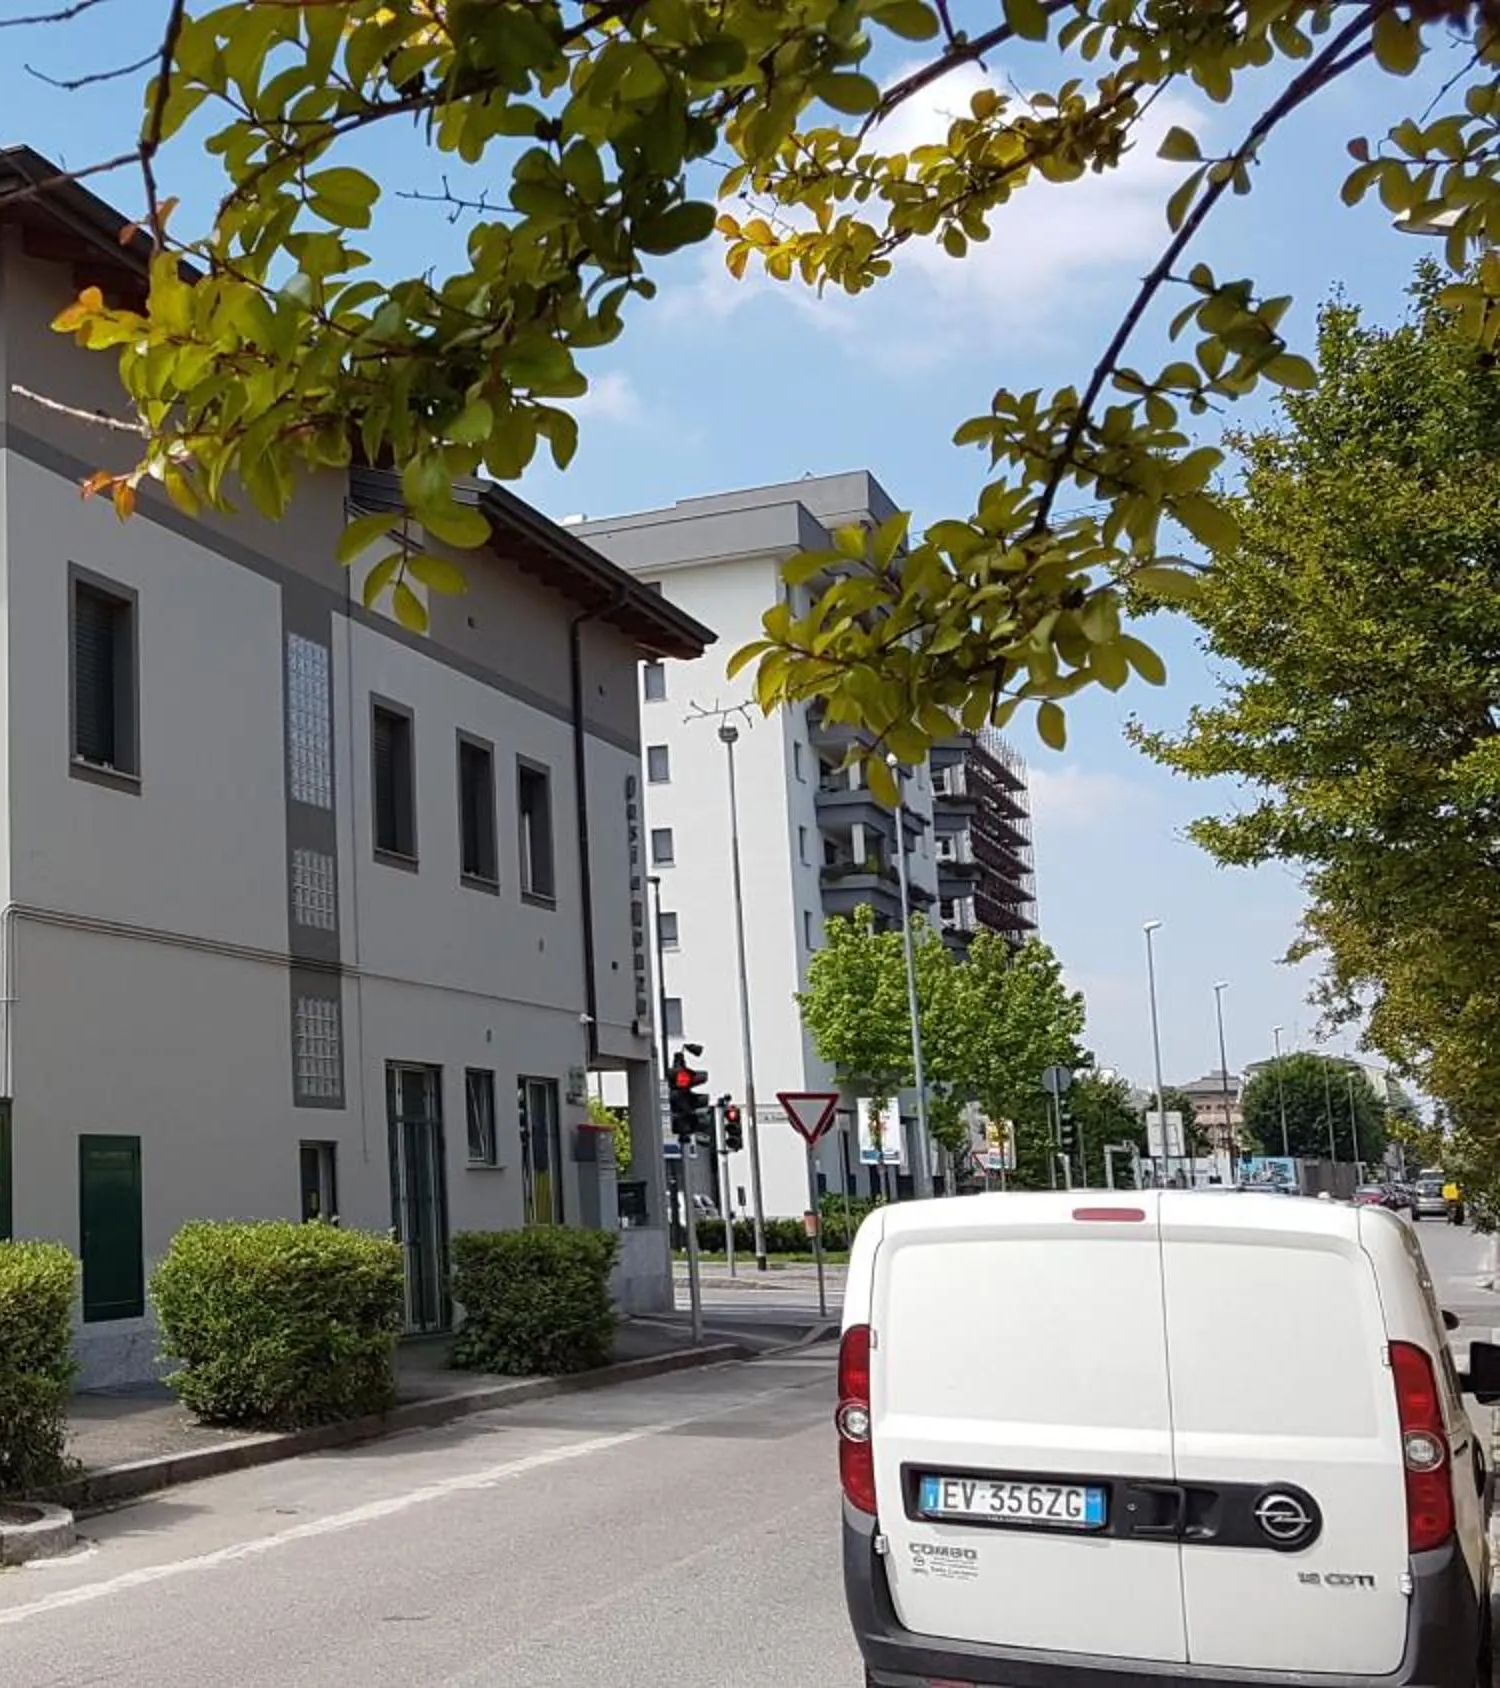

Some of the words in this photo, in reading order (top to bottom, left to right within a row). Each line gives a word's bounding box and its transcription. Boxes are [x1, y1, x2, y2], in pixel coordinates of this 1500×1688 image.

[943, 1481, 976, 1510] EV
[989, 1484, 1082, 1518] 356ZG
[909, 1542, 978, 1560] COMBO
